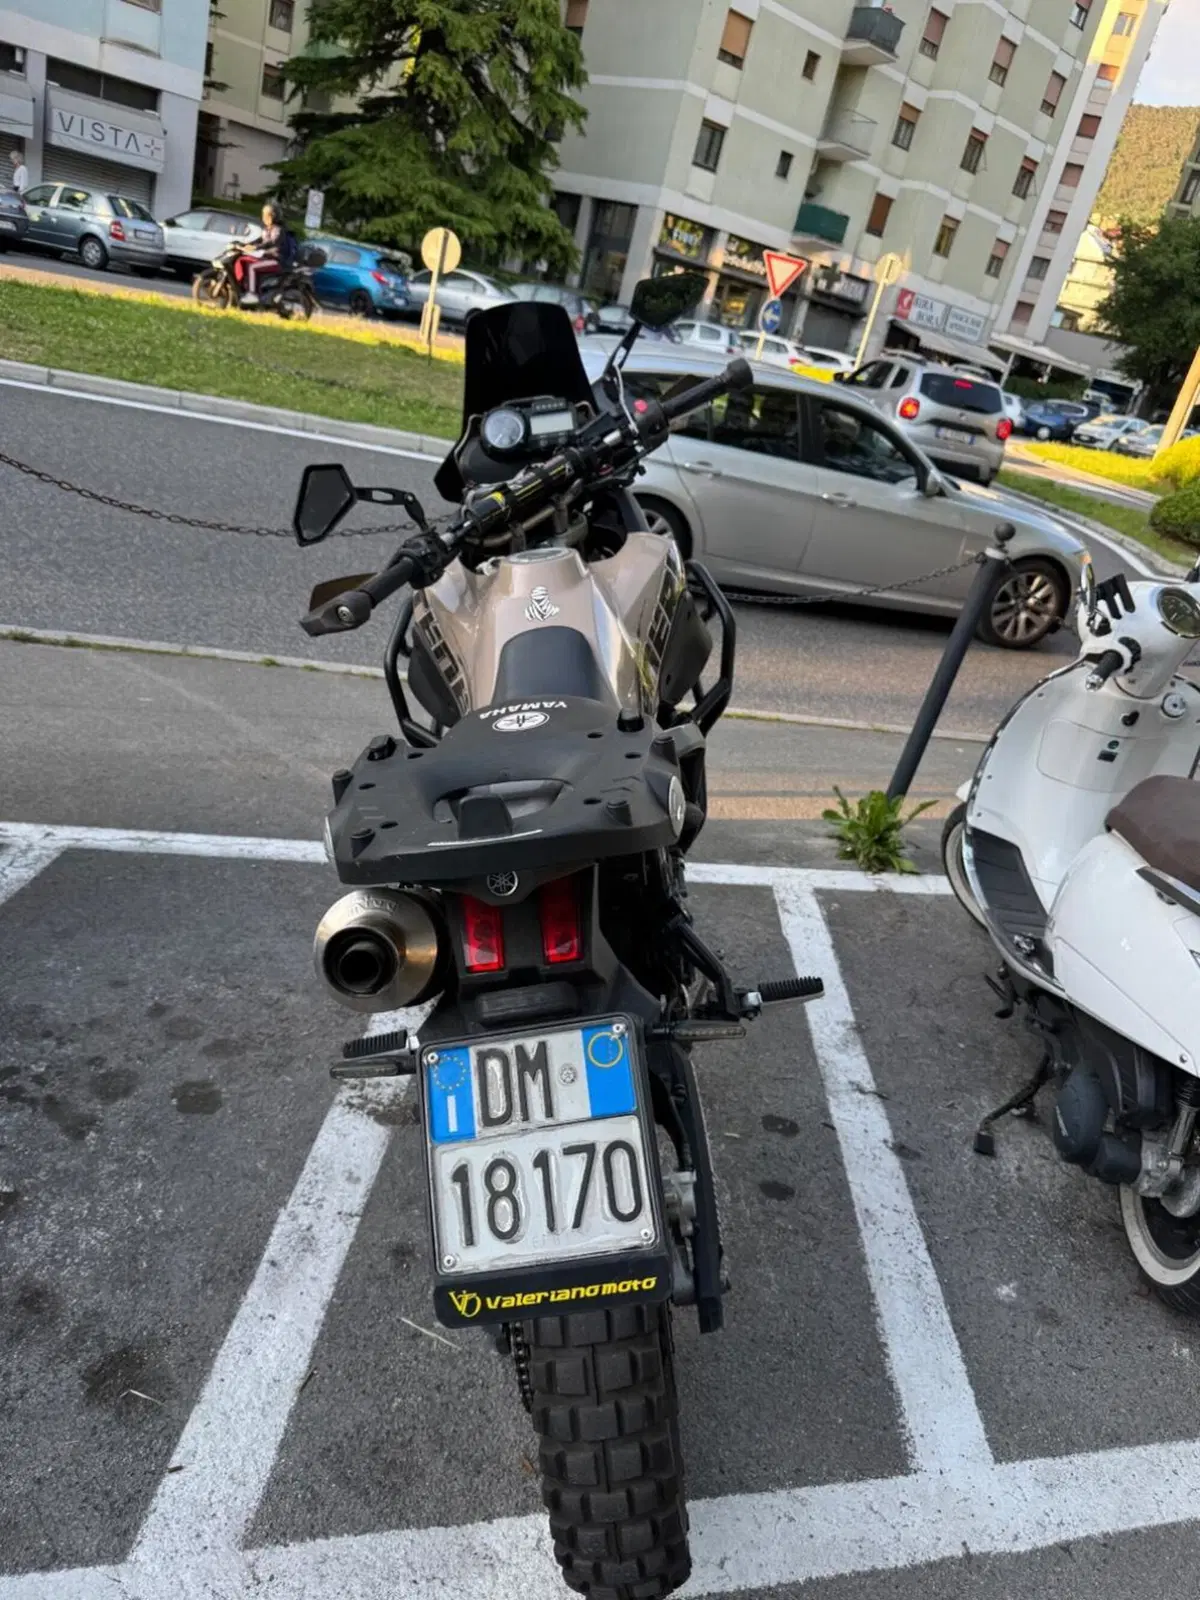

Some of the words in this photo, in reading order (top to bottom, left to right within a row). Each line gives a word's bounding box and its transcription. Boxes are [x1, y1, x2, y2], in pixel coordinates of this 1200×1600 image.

[479, 701, 568, 719] YAMAHA
[476, 1040, 554, 1128] DM
[451, 1139, 644, 1247] 18170
